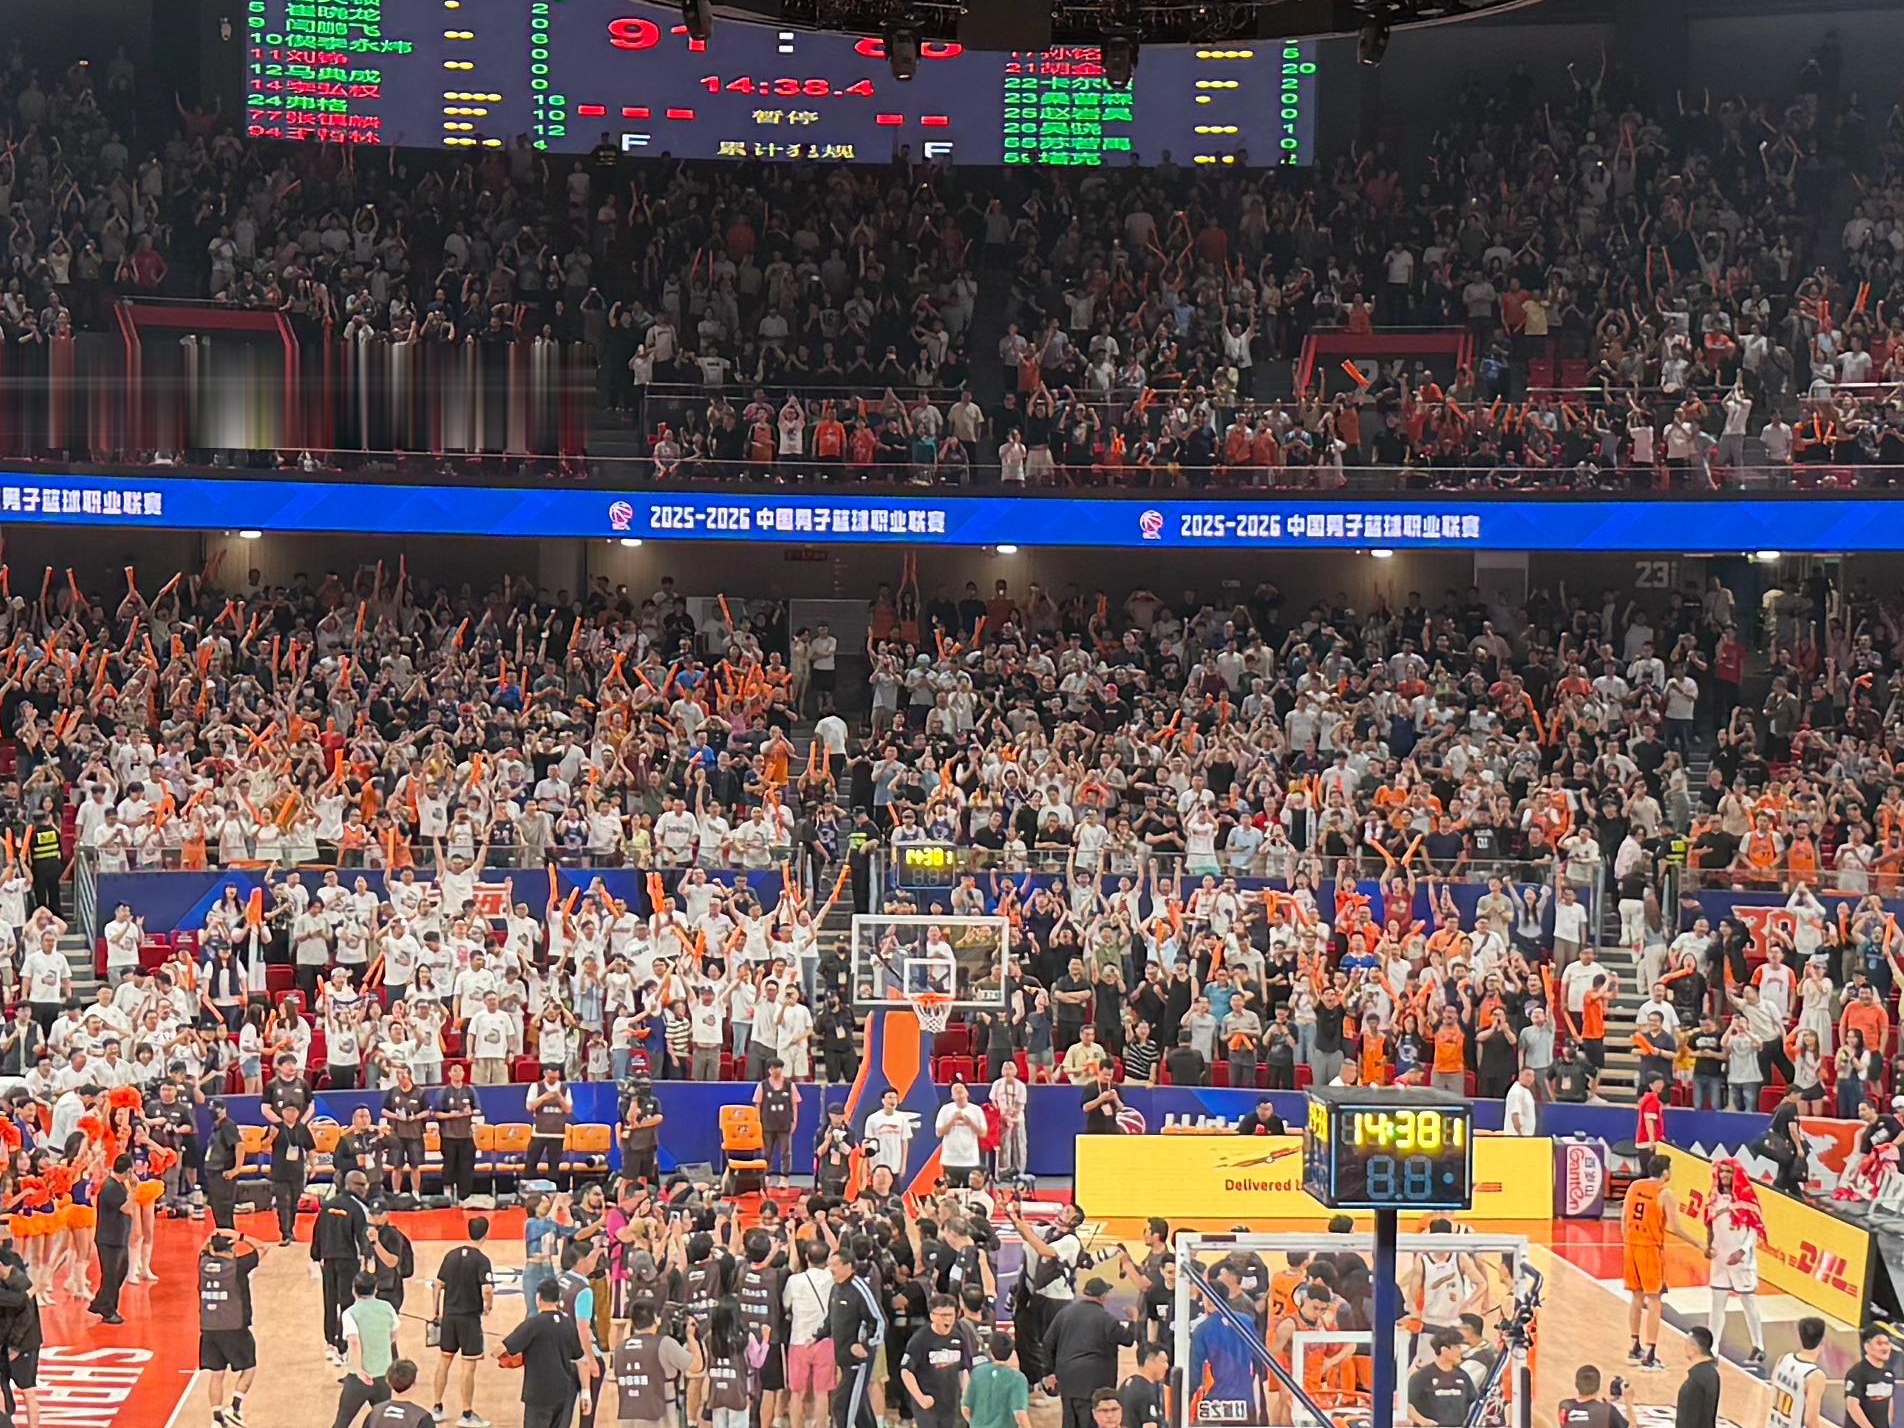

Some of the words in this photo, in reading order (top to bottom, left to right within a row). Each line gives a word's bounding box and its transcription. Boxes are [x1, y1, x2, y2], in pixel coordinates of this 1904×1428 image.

[248, 1, 266, 13] 5
[531, 3, 549, 15] 2
[247, 16, 266, 28] 9
[531, 18, 549, 29] 0
[250, 32, 283, 45] 10
[250, 48, 282, 61] 11
[531, 48, 549, 60] 0
[250, 63, 283, 76] 12
[531, 64, 549, 75] 0
[1282, 63, 1317, 74] 20
[250, 79, 283, 92] 14
[531, 79, 549, 90] 0
[700, 75, 875, 97] 14:38.4
[1004, 77, 1038, 89] 22
[1281, 78, 1299, 89] 2
[248, 94, 283, 107] 24
[1004, 92, 1038, 104] 23
[1281, 93, 1299, 104] 0
[248, 109, 283, 122] 77
[532, 109, 566, 121] 10
[1280, 108, 1298, 119] 0
[247, 125, 283, 138] 94
[622, 133, 651, 152] F
[1280, 138, 1298, 149] 0
[650, 505, 751, 530] 2025-2026
[756, 507, 946, 533] 中国男子篮球职业联赛
[1181, 514, 1281, 538] 2025-2026
[1287, 514, 1480, 539] 中国男子篮球职业联赛
[1224, 1178, 1292, 1192] Delivered
